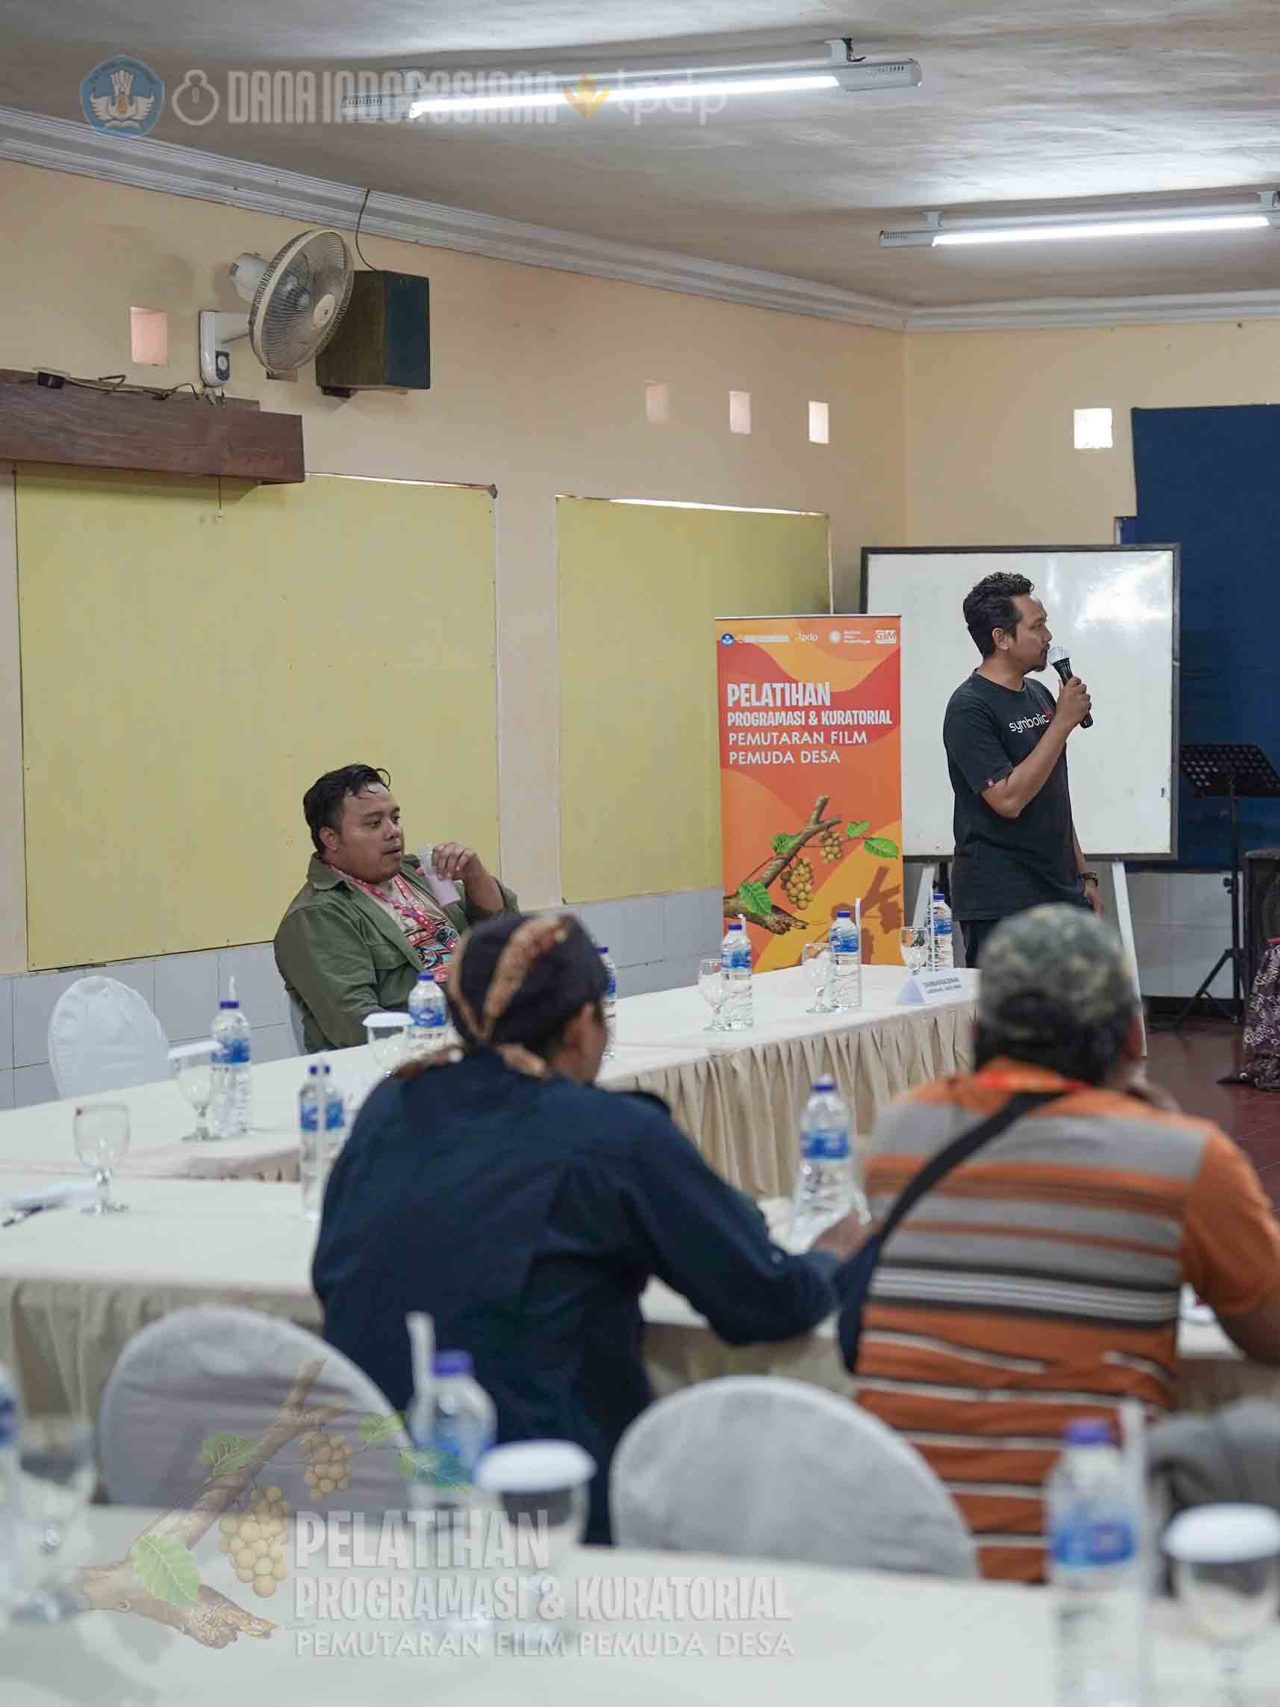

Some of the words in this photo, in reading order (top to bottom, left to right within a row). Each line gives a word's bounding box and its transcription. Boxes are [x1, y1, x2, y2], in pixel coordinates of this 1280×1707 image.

[727, 681, 831, 708] PELATIHAN
[727, 710, 806, 727] PROGRAMASI
[808, 711, 818, 726] &
[821, 709, 893, 726] KURATORIAL
[1008, 713, 1050, 734] symbolic
[728, 730, 825, 746] PEMUTARAN
[830, 729, 868, 745] FILM
[728, 750, 795, 765] PEMUDA
[800, 749, 841, 764] DESA
